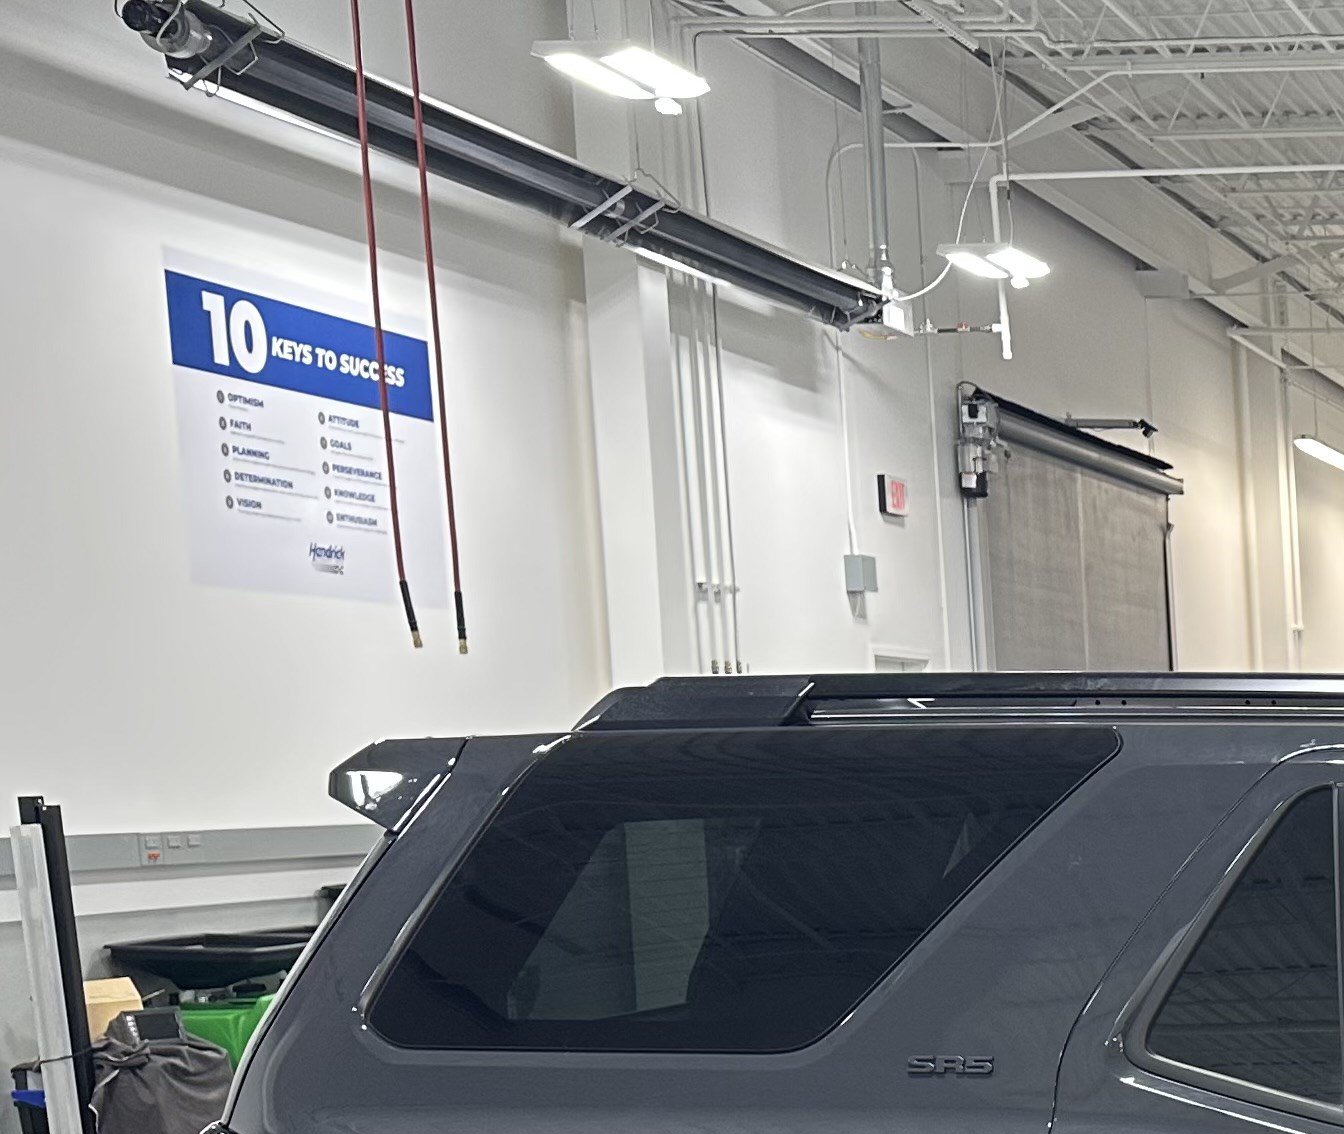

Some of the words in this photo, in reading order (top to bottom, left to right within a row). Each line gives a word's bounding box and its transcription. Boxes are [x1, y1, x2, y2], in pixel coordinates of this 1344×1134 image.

[201, 290, 268, 374] 10
[271, 336, 313, 365] KEYS
[315, 347, 338, 371] TO
[227, 392, 264, 408] OPTIMISM
[229, 418, 252, 431] FAITH
[329, 438, 352, 451] GOALS
[232, 445, 270, 460] PLANNING
[234, 471, 294, 489] DETERMINATION
[236, 497, 262, 509] VISION
